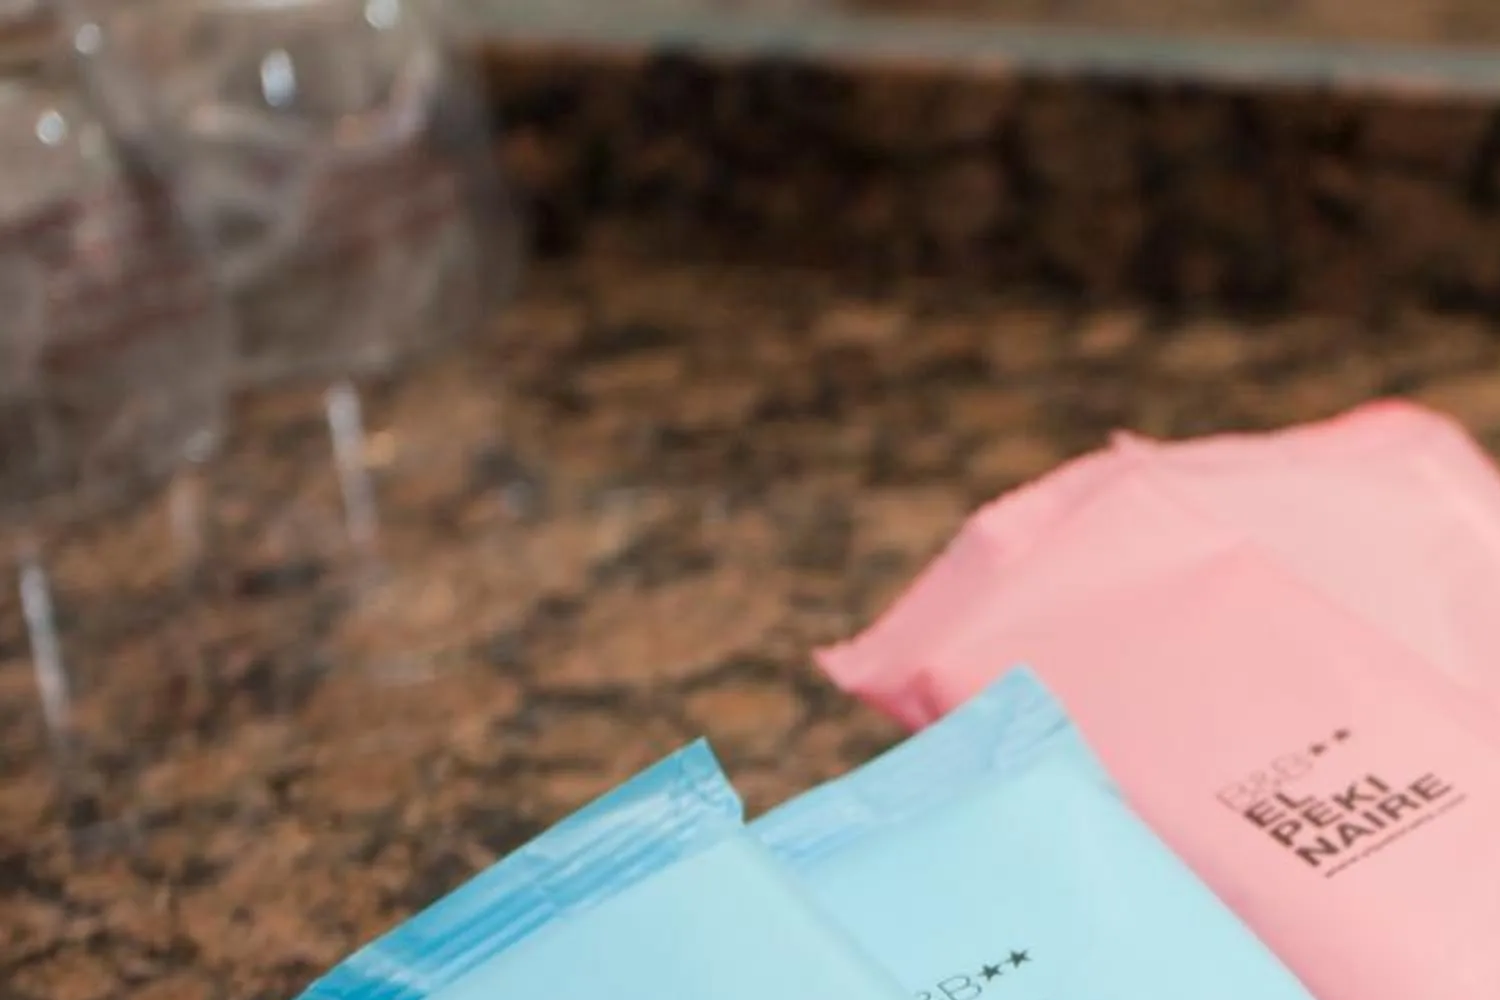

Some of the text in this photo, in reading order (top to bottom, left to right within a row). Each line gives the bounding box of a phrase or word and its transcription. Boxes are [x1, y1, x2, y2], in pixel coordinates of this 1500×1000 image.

[1243, 791, 1317, 830] EL
[1269, 774, 1391, 848] PEKI
[1294, 772, 1454, 868] NAIRE
